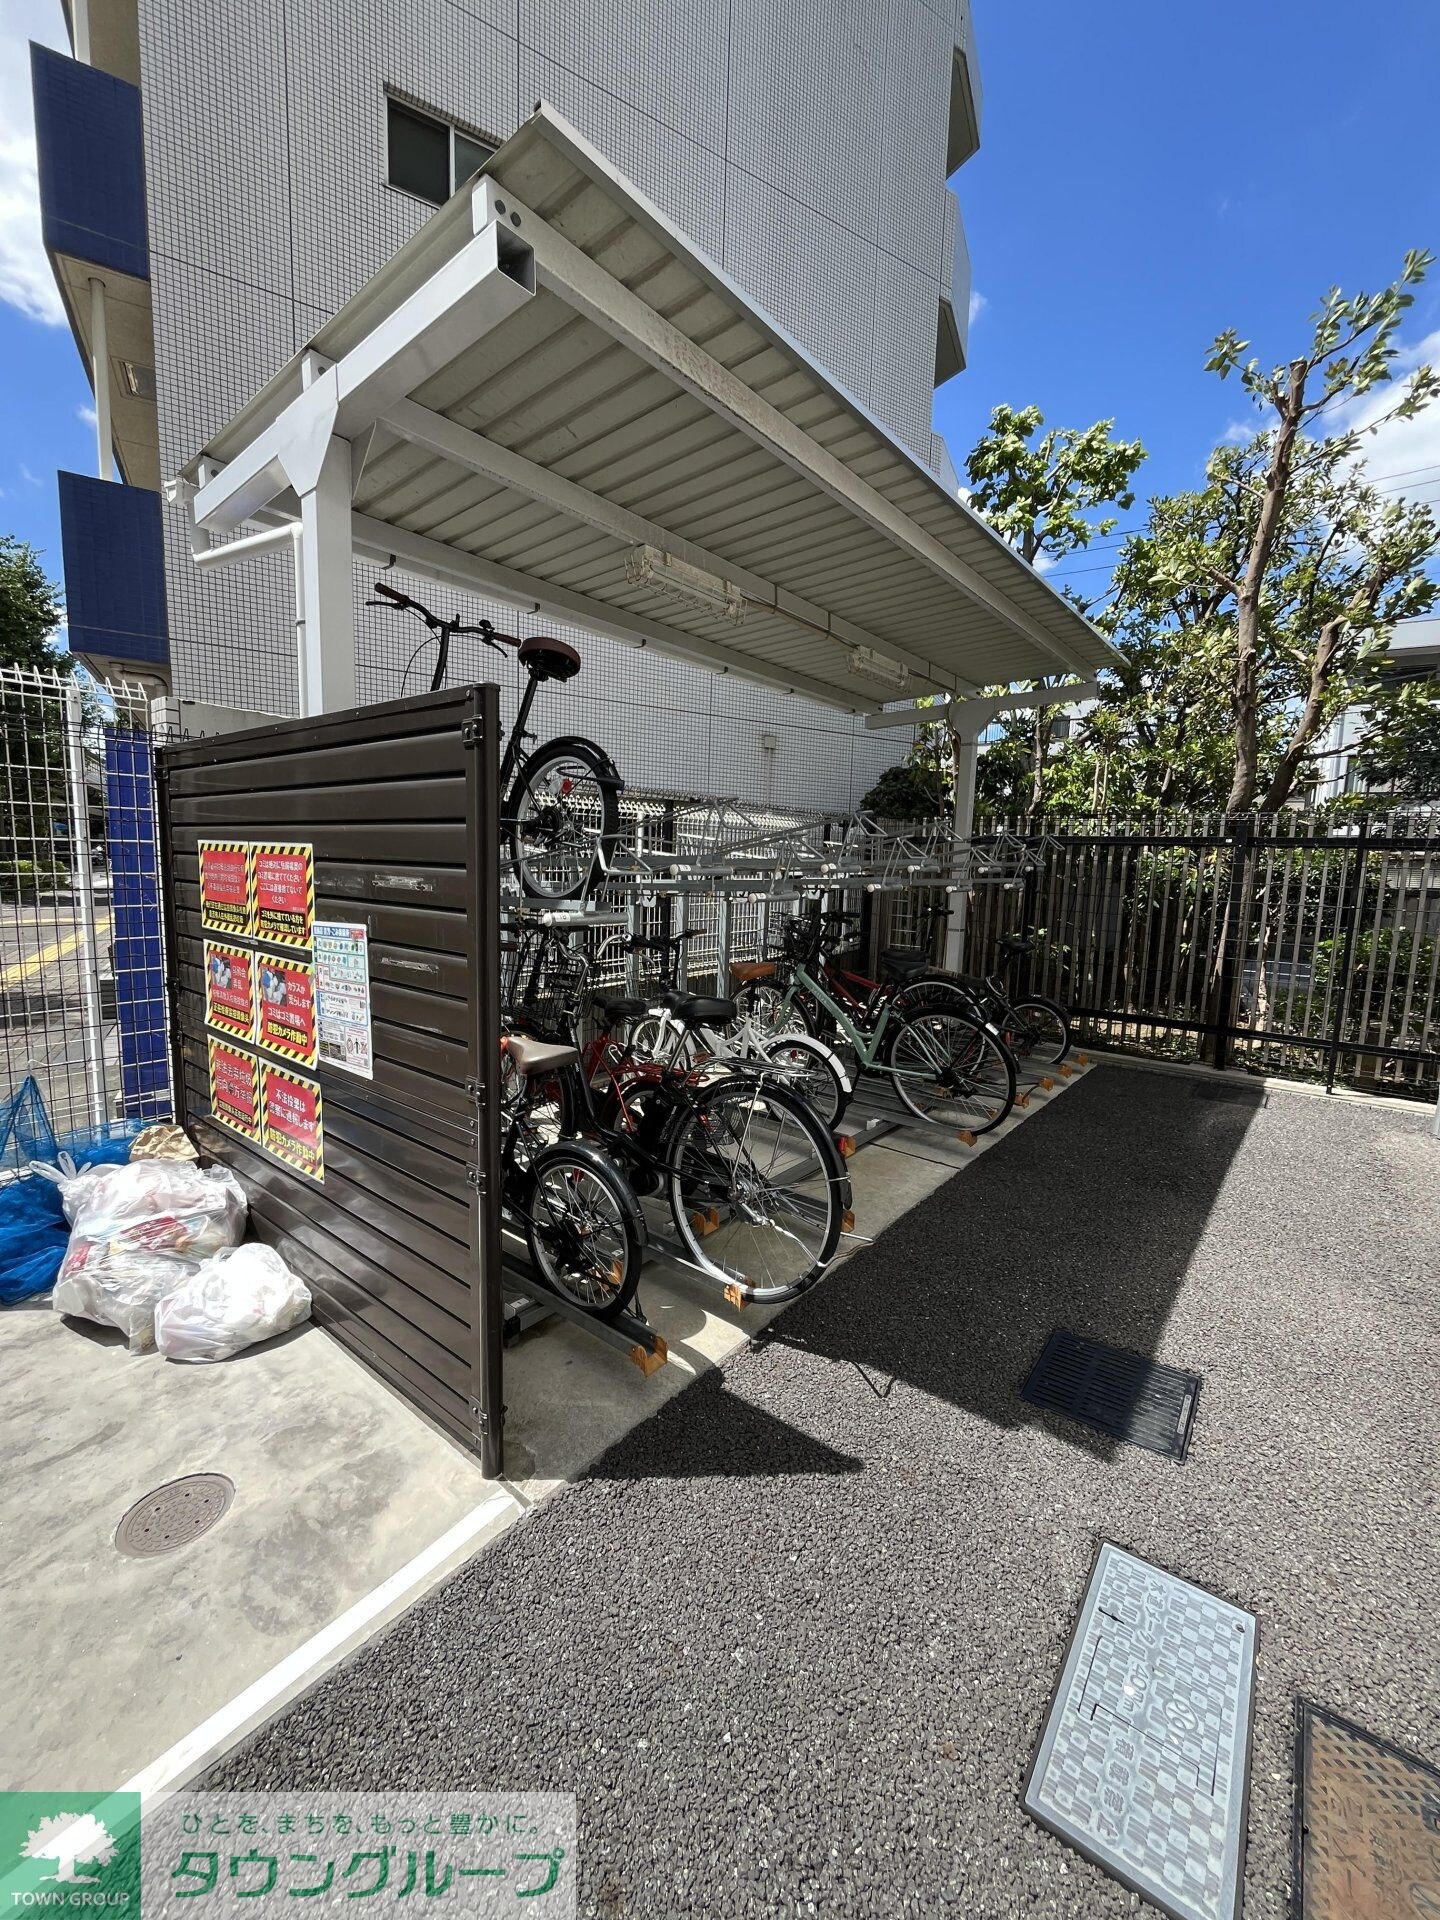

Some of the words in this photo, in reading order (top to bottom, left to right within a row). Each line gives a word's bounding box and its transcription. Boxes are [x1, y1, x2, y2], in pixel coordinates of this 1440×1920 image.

[275, 1088, 306, 1112] 不法投棄は
[268, 1100, 314, 1132] 警察に通報します
